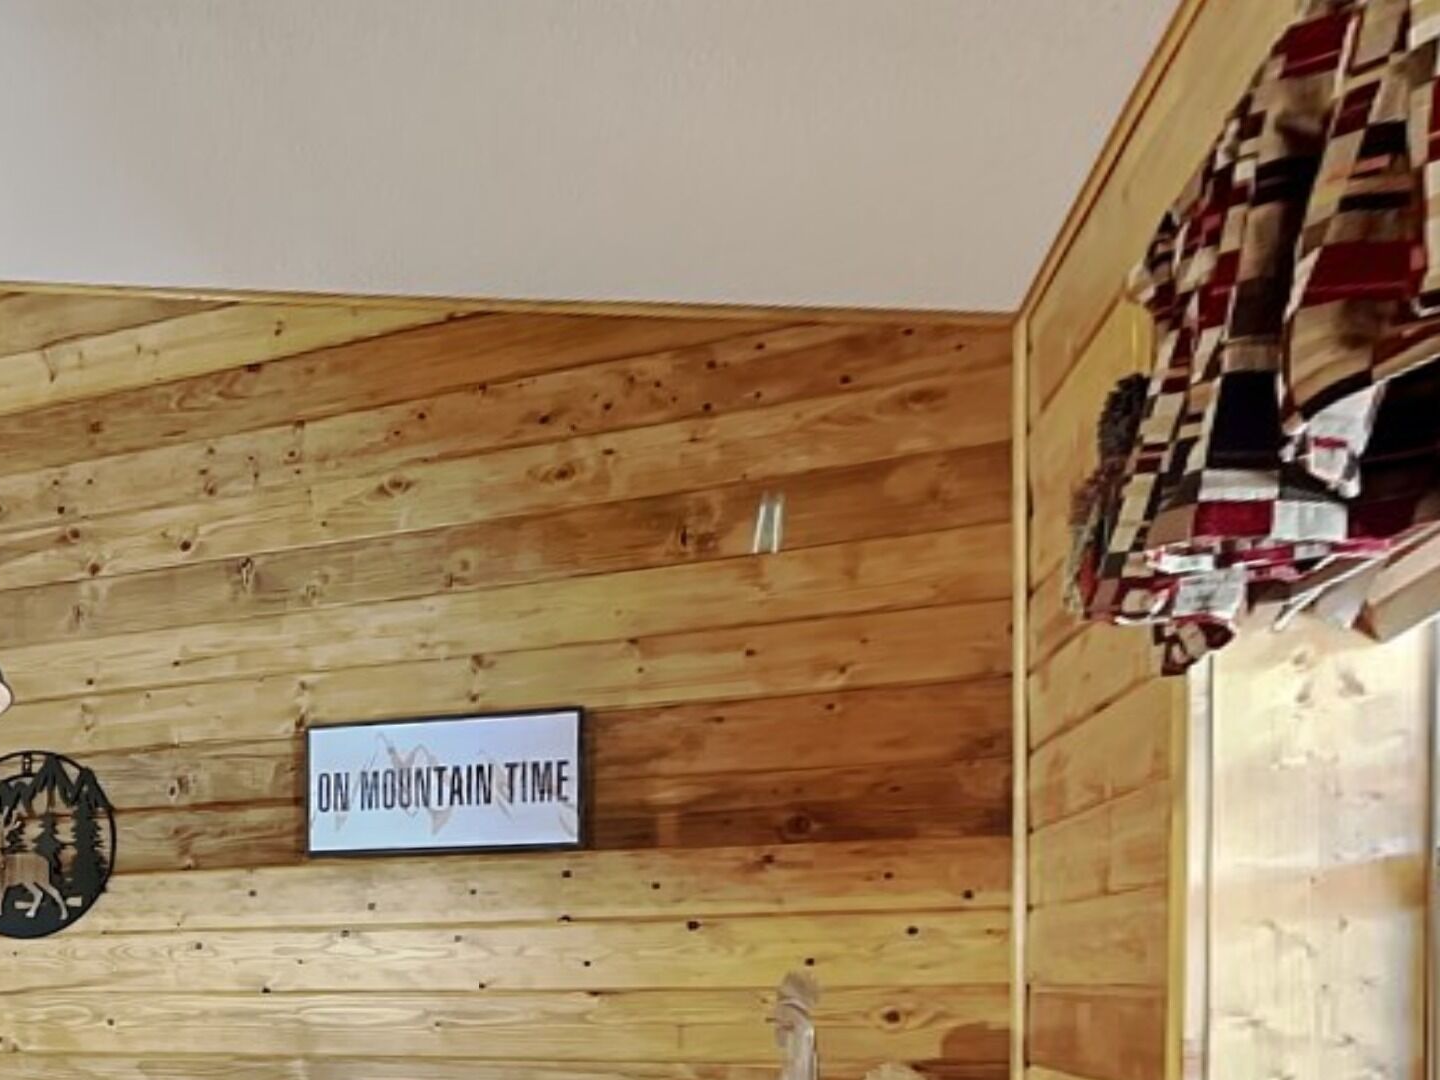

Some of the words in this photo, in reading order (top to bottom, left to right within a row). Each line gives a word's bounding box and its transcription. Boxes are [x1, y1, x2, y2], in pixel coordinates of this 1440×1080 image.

[318, 772, 349, 812] ON
[360, 764, 492, 811] MOUNTAIN
[504, 760, 569, 804] TIME
